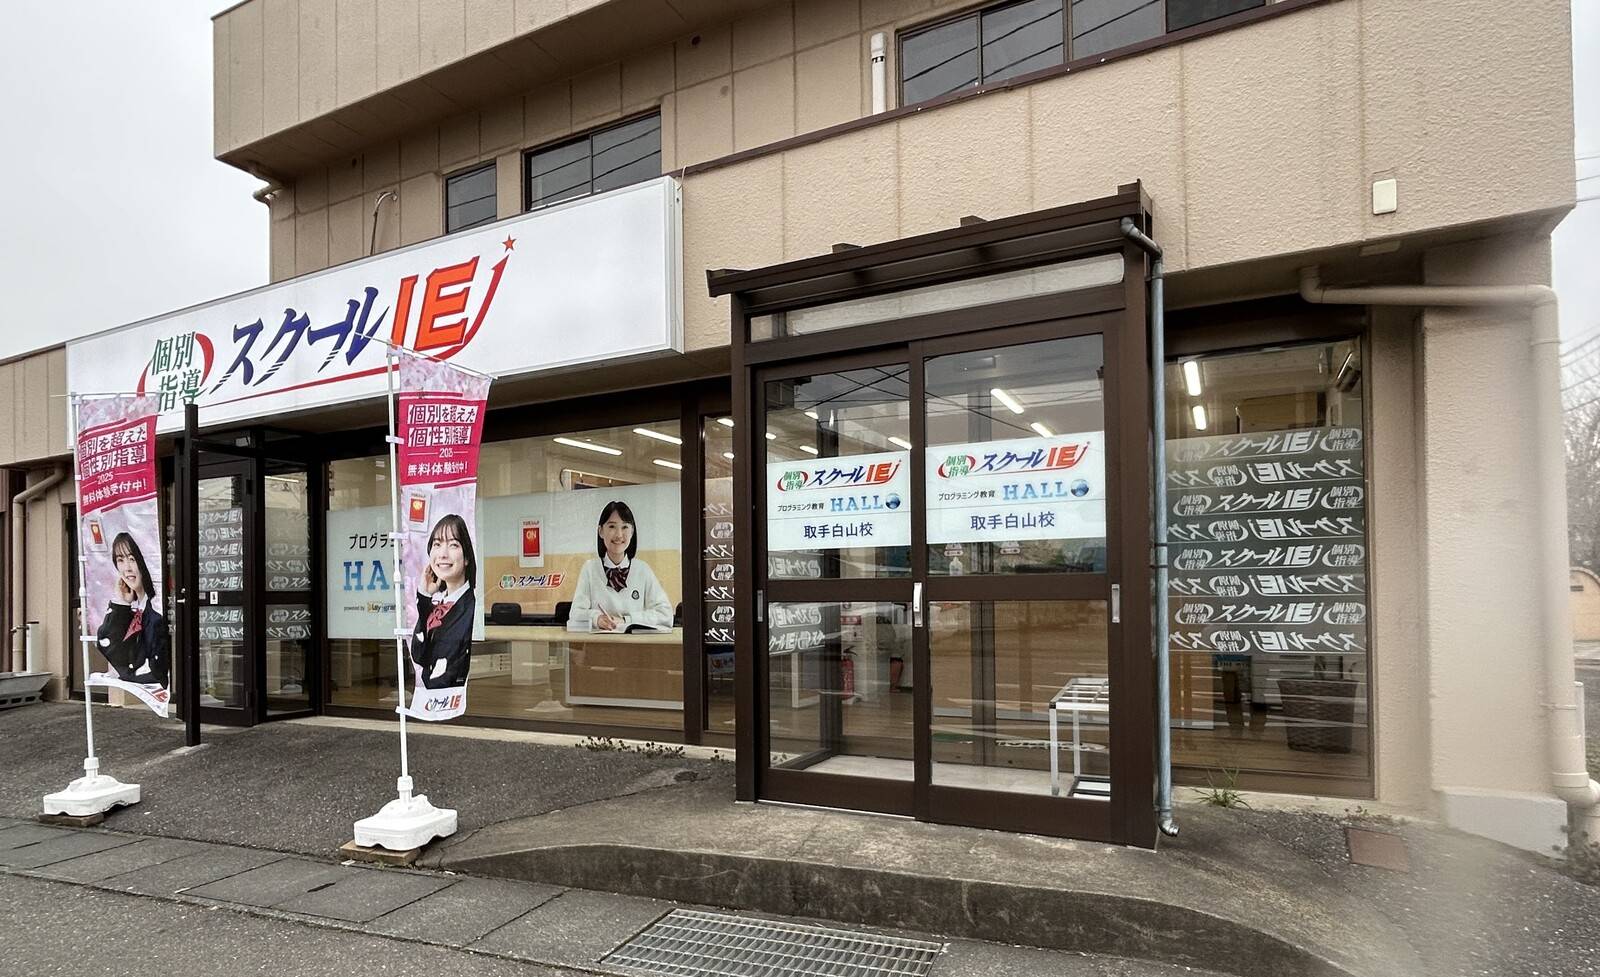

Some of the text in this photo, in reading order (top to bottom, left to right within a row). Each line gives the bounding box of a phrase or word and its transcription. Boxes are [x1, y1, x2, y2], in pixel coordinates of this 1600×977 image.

[152, 331, 196, 376] 個別
[157, 368, 201, 413] 指導
[409, 404, 476, 424] 個別を超えた
[409, 427, 470, 446] 個性別指導
[946, 455, 967, 466] 個別
[974, 444, 1078, 472] スクールIE
[97, 472, 114, 484] 2025
[807, 463, 892, 487] スクールIE
[938, 491, 995, 501] プログラミング教育
[777, 502, 825, 512] プログラミング教育
[804, 522, 873, 538] 取手白山校
[970, 511, 1055, 530] 取手白山校
[349, 532, 403, 549] プログラ
